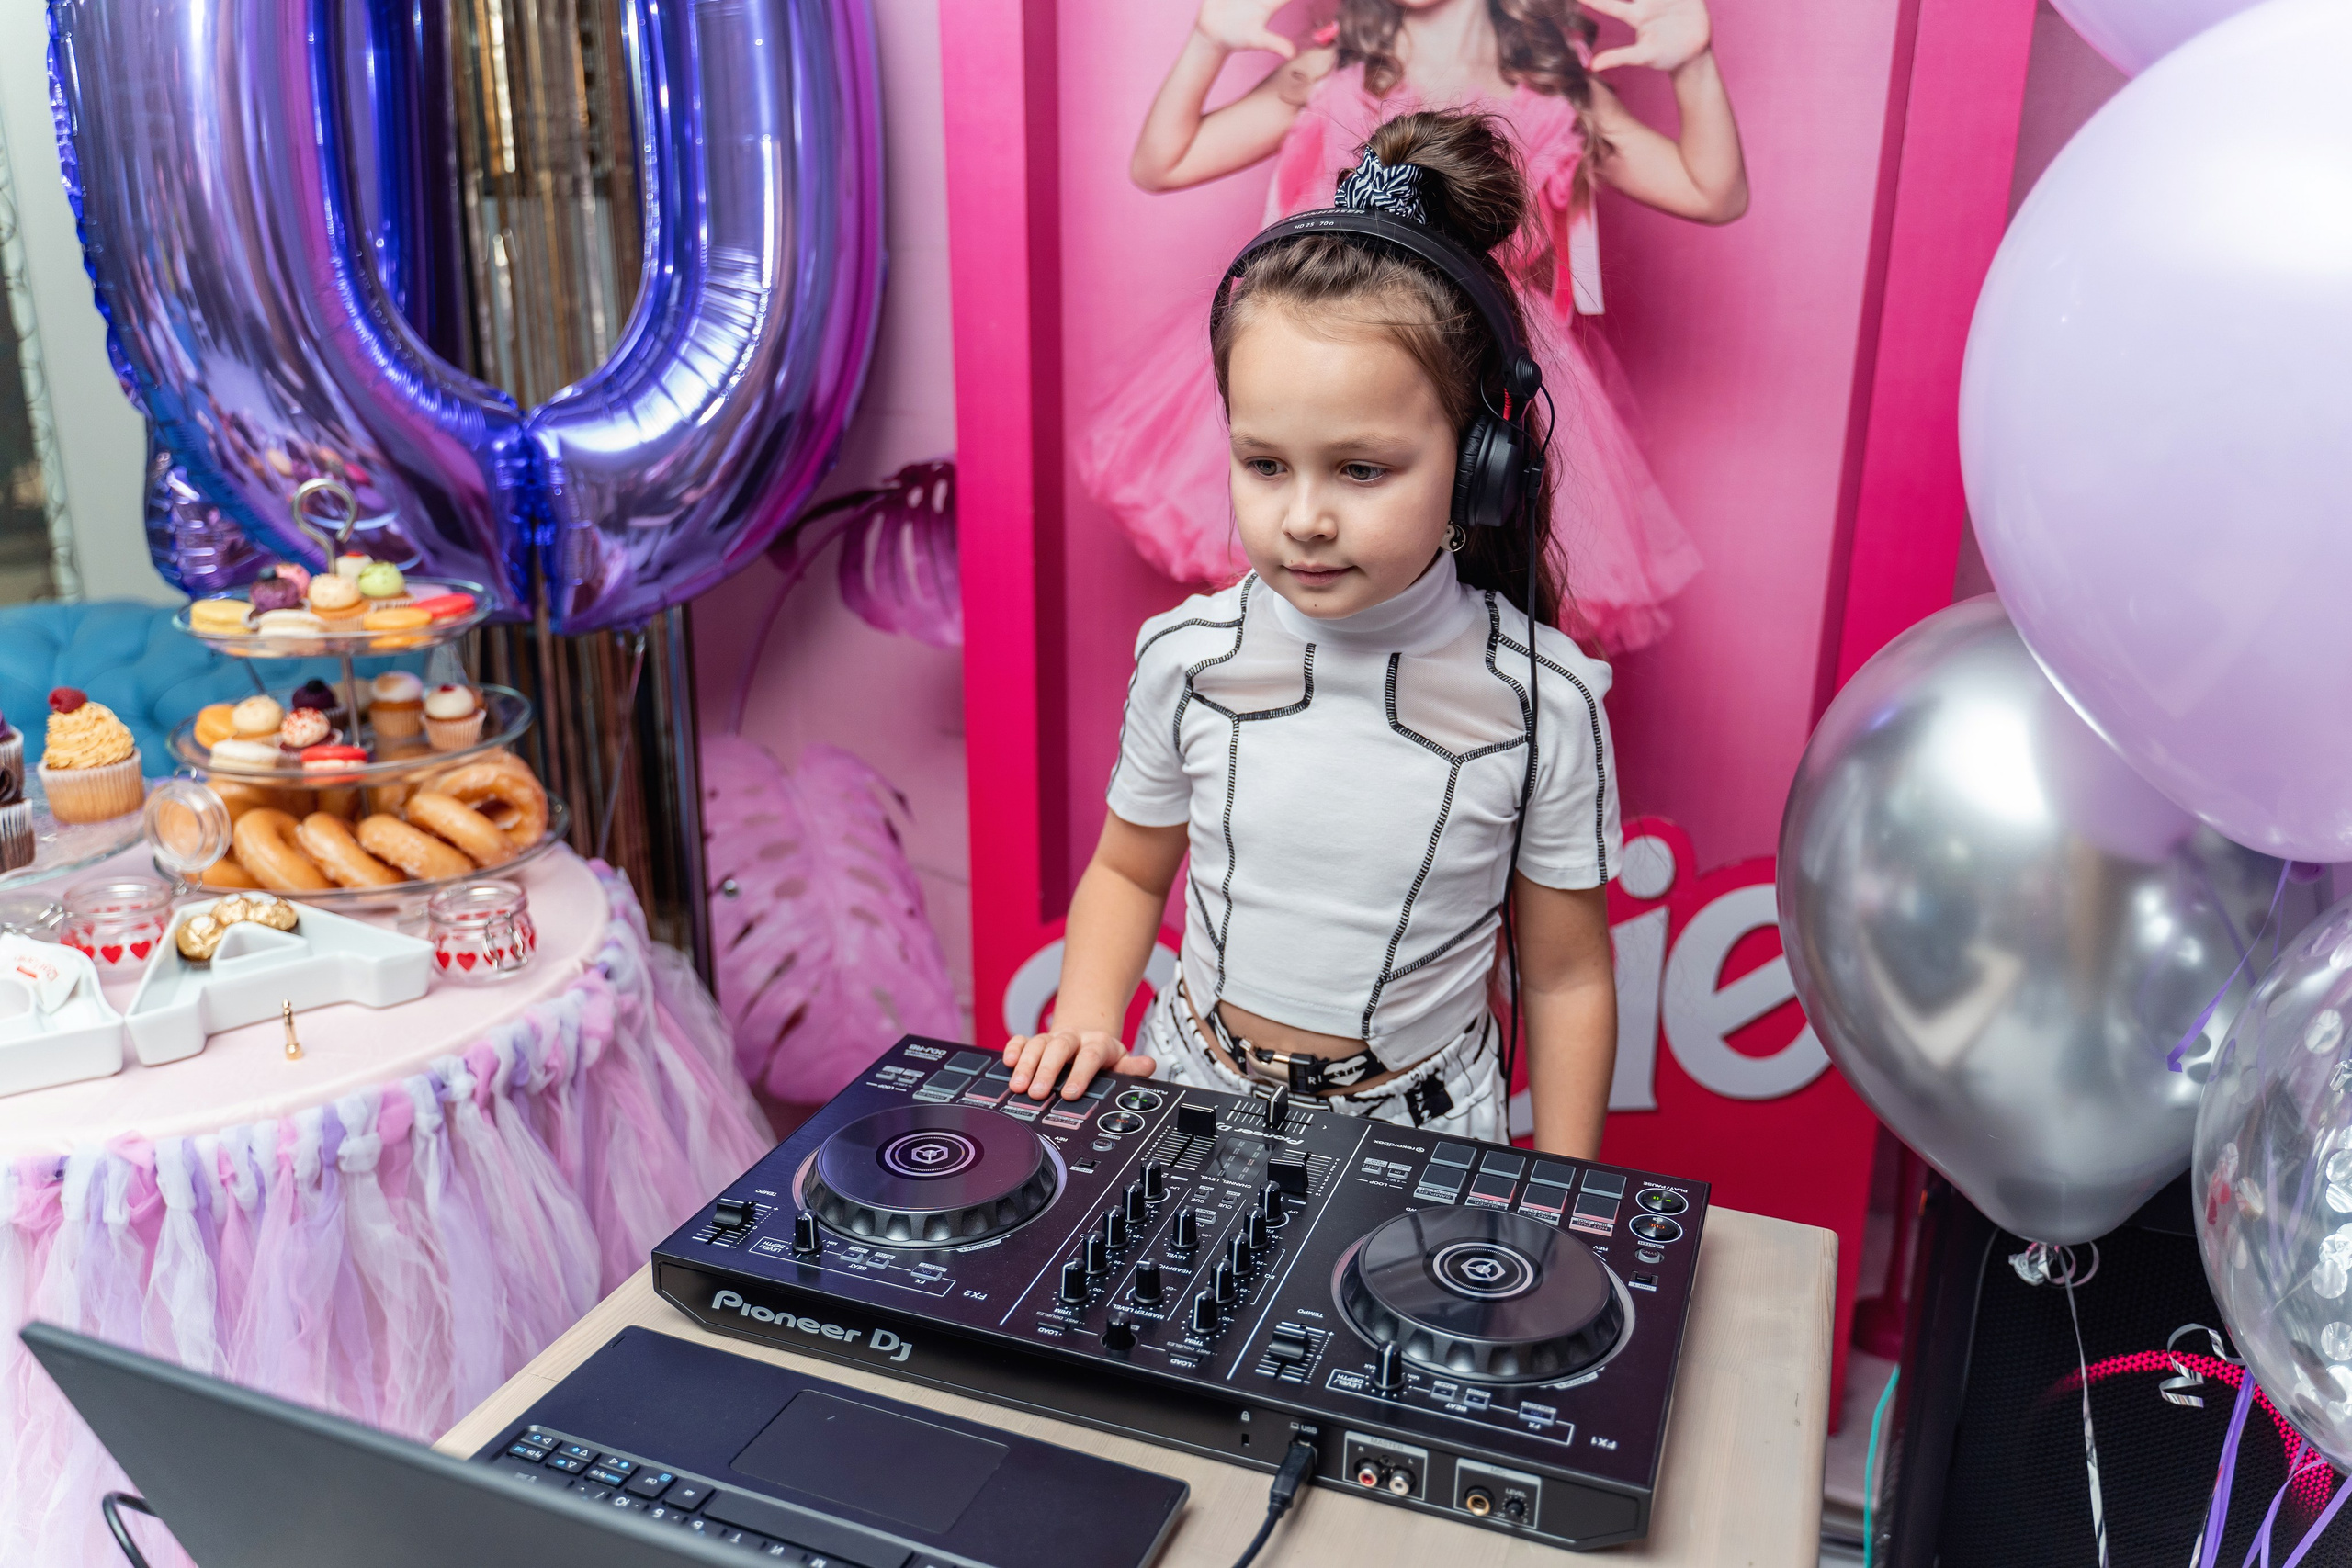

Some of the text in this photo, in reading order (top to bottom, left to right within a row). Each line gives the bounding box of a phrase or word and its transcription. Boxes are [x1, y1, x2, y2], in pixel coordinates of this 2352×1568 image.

[1129, 1085, 1169, 1095] PLAY/PAUSE
[1233, 1127, 1305, 1145] Pioneer
[1374, 1139, 1416, 1151] rekordbox
[1222, 1179, 1252, 1189] CHANNEL
[1643, 1181, 1688, 1193] PLAY/PAUSE
[755, 1189, 777, 1197] TEMPO
[757, 1245, 781, 1253] LEVEL/
[763, 1241, 786, 1249] DEPTH
[1165, 1252, 1186, 1260] LEVEL
[848, 1263, 868, 1271] BEAT
[1159, 1263, 1193, 1275] HEADPHO
[963, 1290, 988, 1301] FX2
[711, 1290, 862, 1342] Pioneer
[1035, 1310, 1064, 1320] DOUBLES
[1054, 1307, 1072, 1315] TRIM
[1112, 1303, 1164, 1320] MASTER LEVEL
[1297, 1308, 1323, 1318] TEMPO
[1037, 1327, 1059, 1336] LOAD
[1166, 1341, 1195, 1352] DOUBLES
[1184, 1337, 1204, 1347] TRIM
[1170, 1359, 1193, 1367] LOAD
[1332, 1378, 1362, 1389] LEVEL/
[1336, 1373, 1364, 1384] DEPTH
[1444, 1403, 1468, 1413] BEAT
[1301, 1424, 1317, 1434] USB
[1370, 1438, 1405, 1451] MASTER
[1590, 1436, 1617, 1450] FX1
[514, 1445, 526, 1453] End
[645, 1476, 658, 1485] Ctrl
[1505, 1488, 1527, 1498] LEVEL
[616, 1496, 630, 1506] Ю
[652, 1507, 665, 1517] Б
[770, 1544, 785, 1555] И
